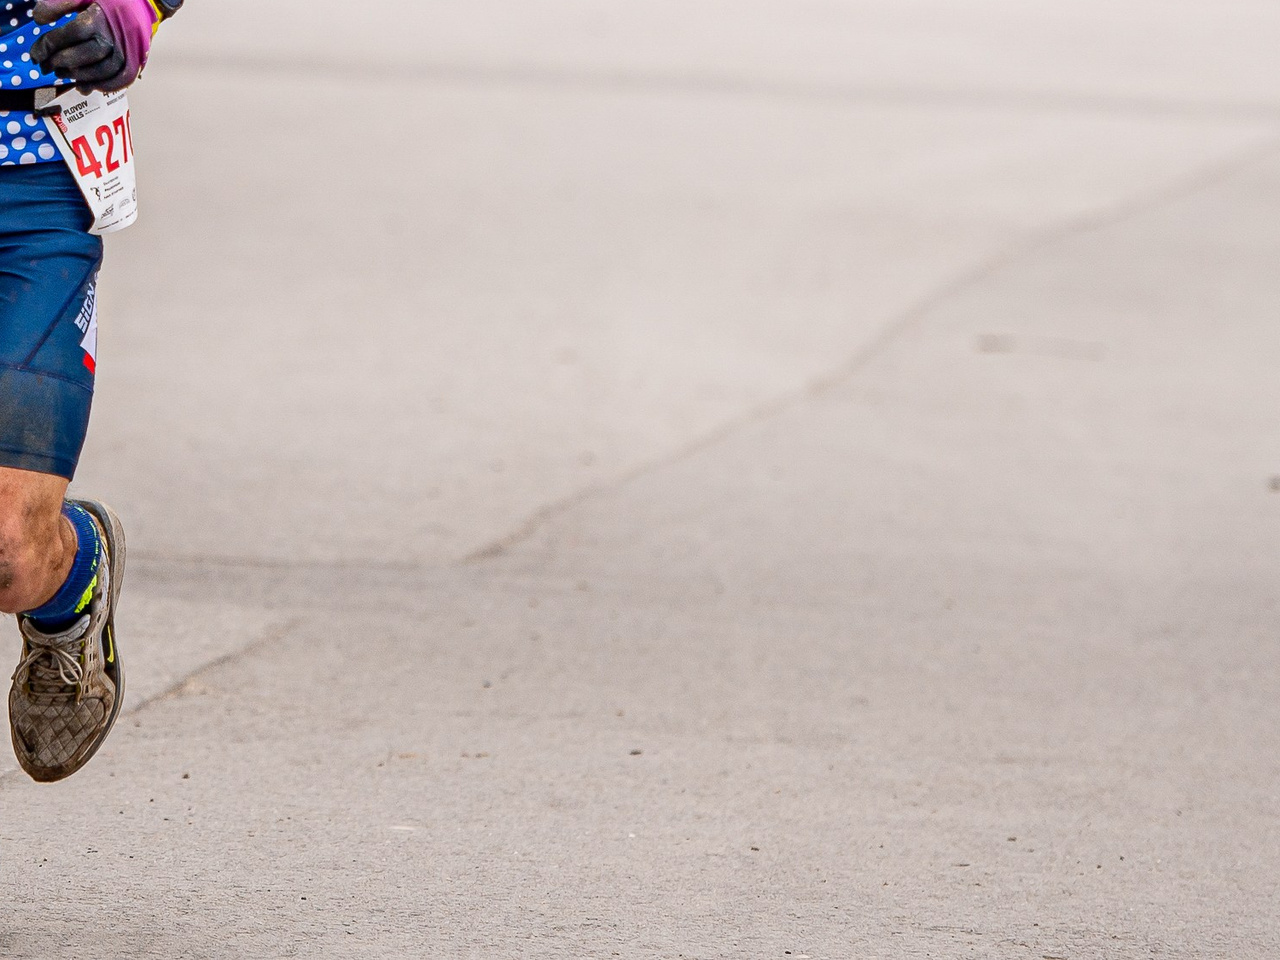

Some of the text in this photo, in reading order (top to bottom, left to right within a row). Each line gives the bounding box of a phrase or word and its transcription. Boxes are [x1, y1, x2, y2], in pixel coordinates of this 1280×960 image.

[63, 100, 88, 116] PLOVDIV
[67, 111, 85, 124] HILLS
[71, 109, 134, 179] 427
